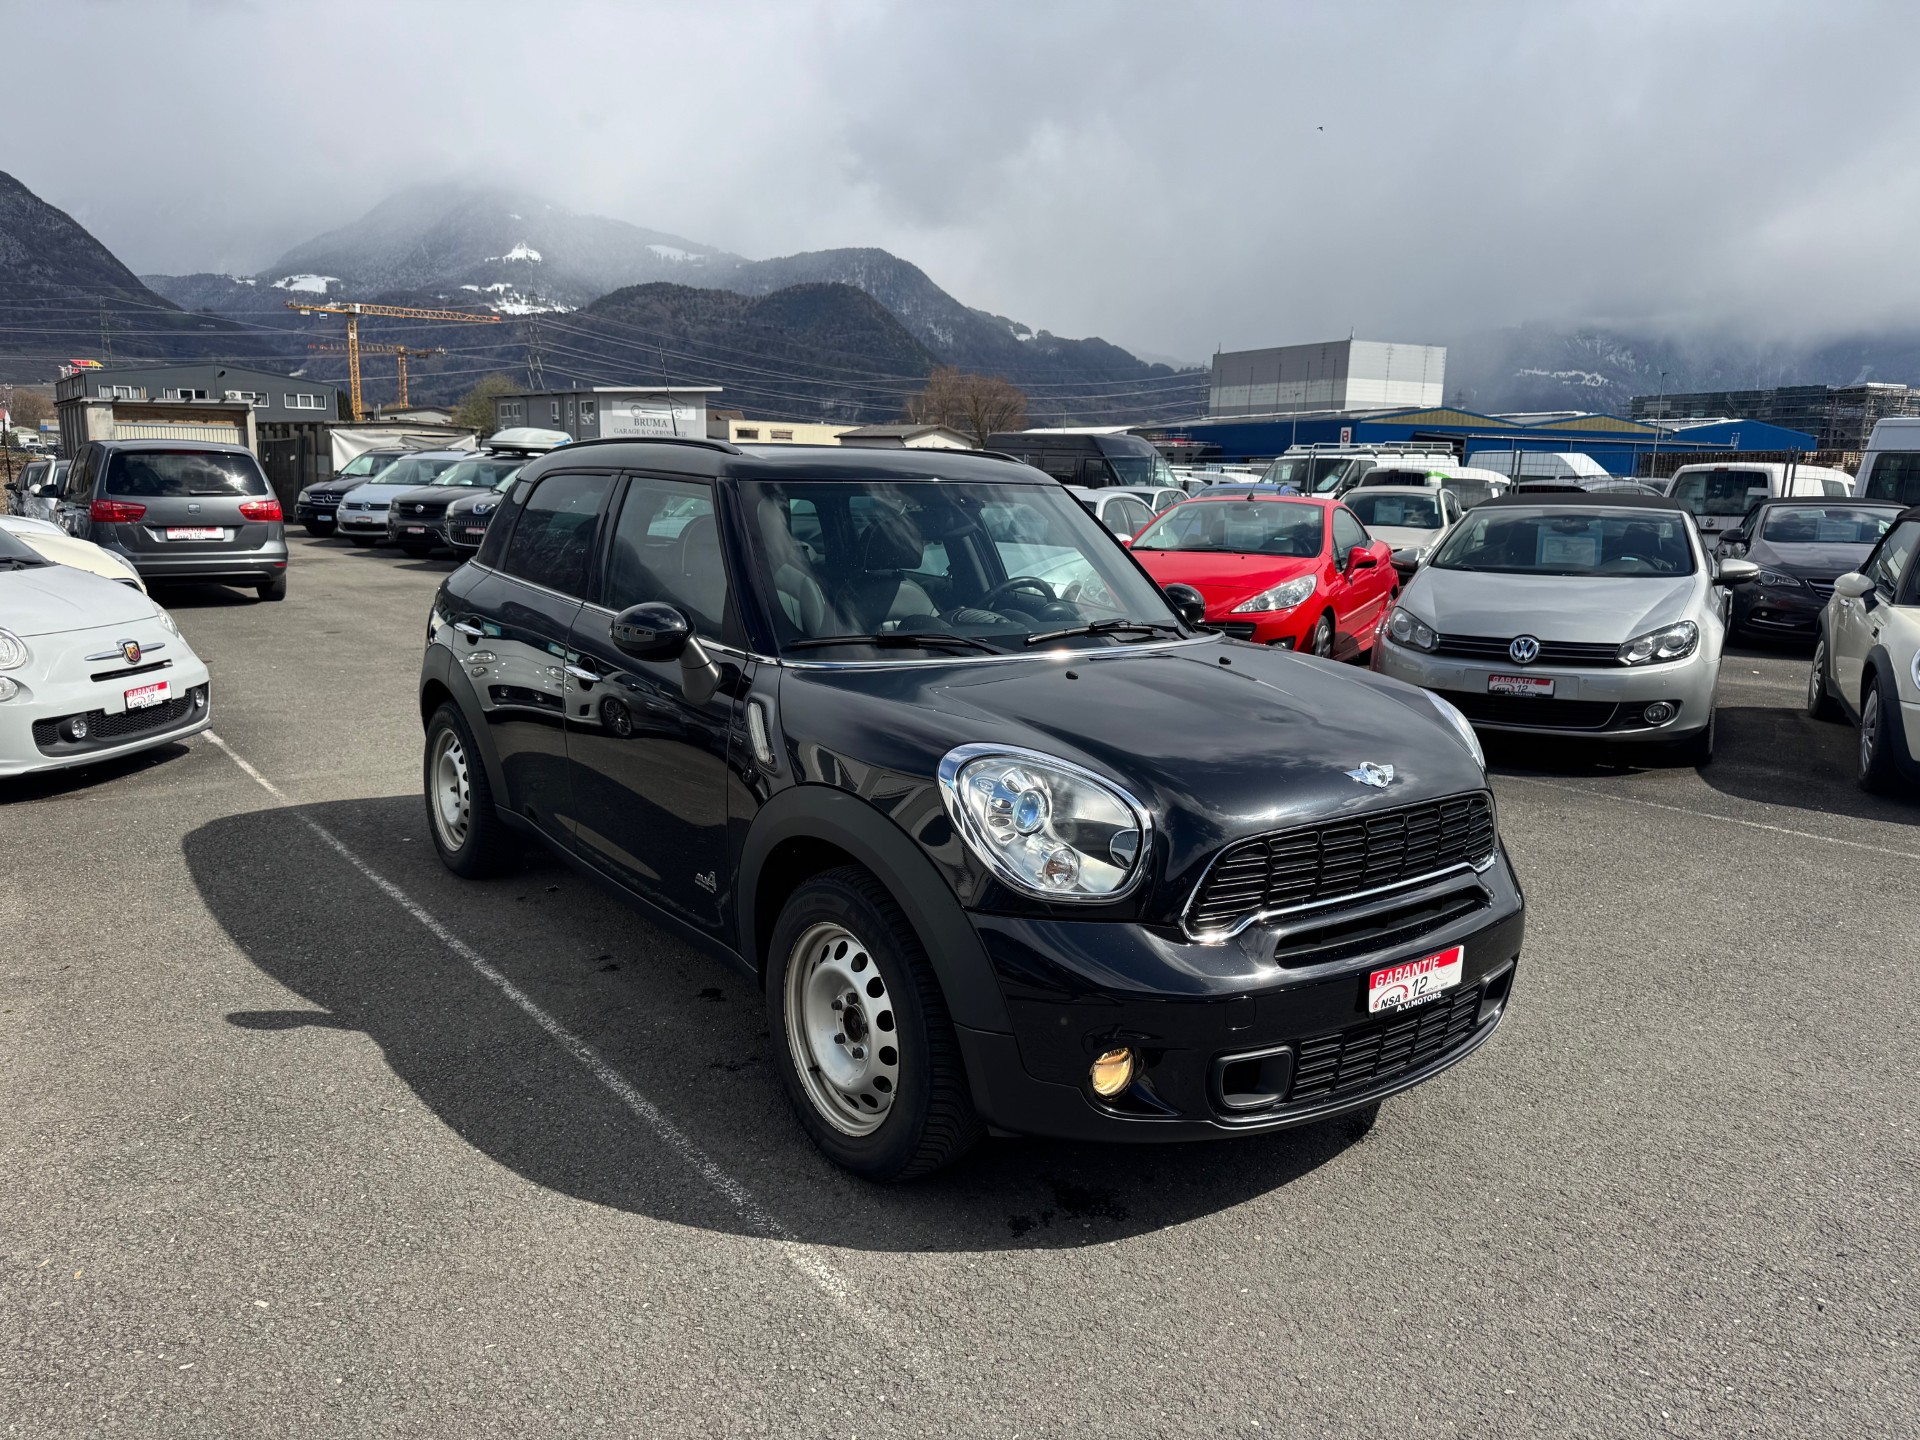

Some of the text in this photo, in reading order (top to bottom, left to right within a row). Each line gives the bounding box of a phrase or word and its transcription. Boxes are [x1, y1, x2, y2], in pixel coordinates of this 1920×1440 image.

[634, 418, 668, 428] BRUMA
[1493, 676, 1537, 685] GARANTIE
[128, 685, 159, 698] GARANTIE
[1374, 956, 1441, 987] GARANTIE
[1380, 994, 1401, 1009] NSA
[1412, 975, 1429, 997] 12
